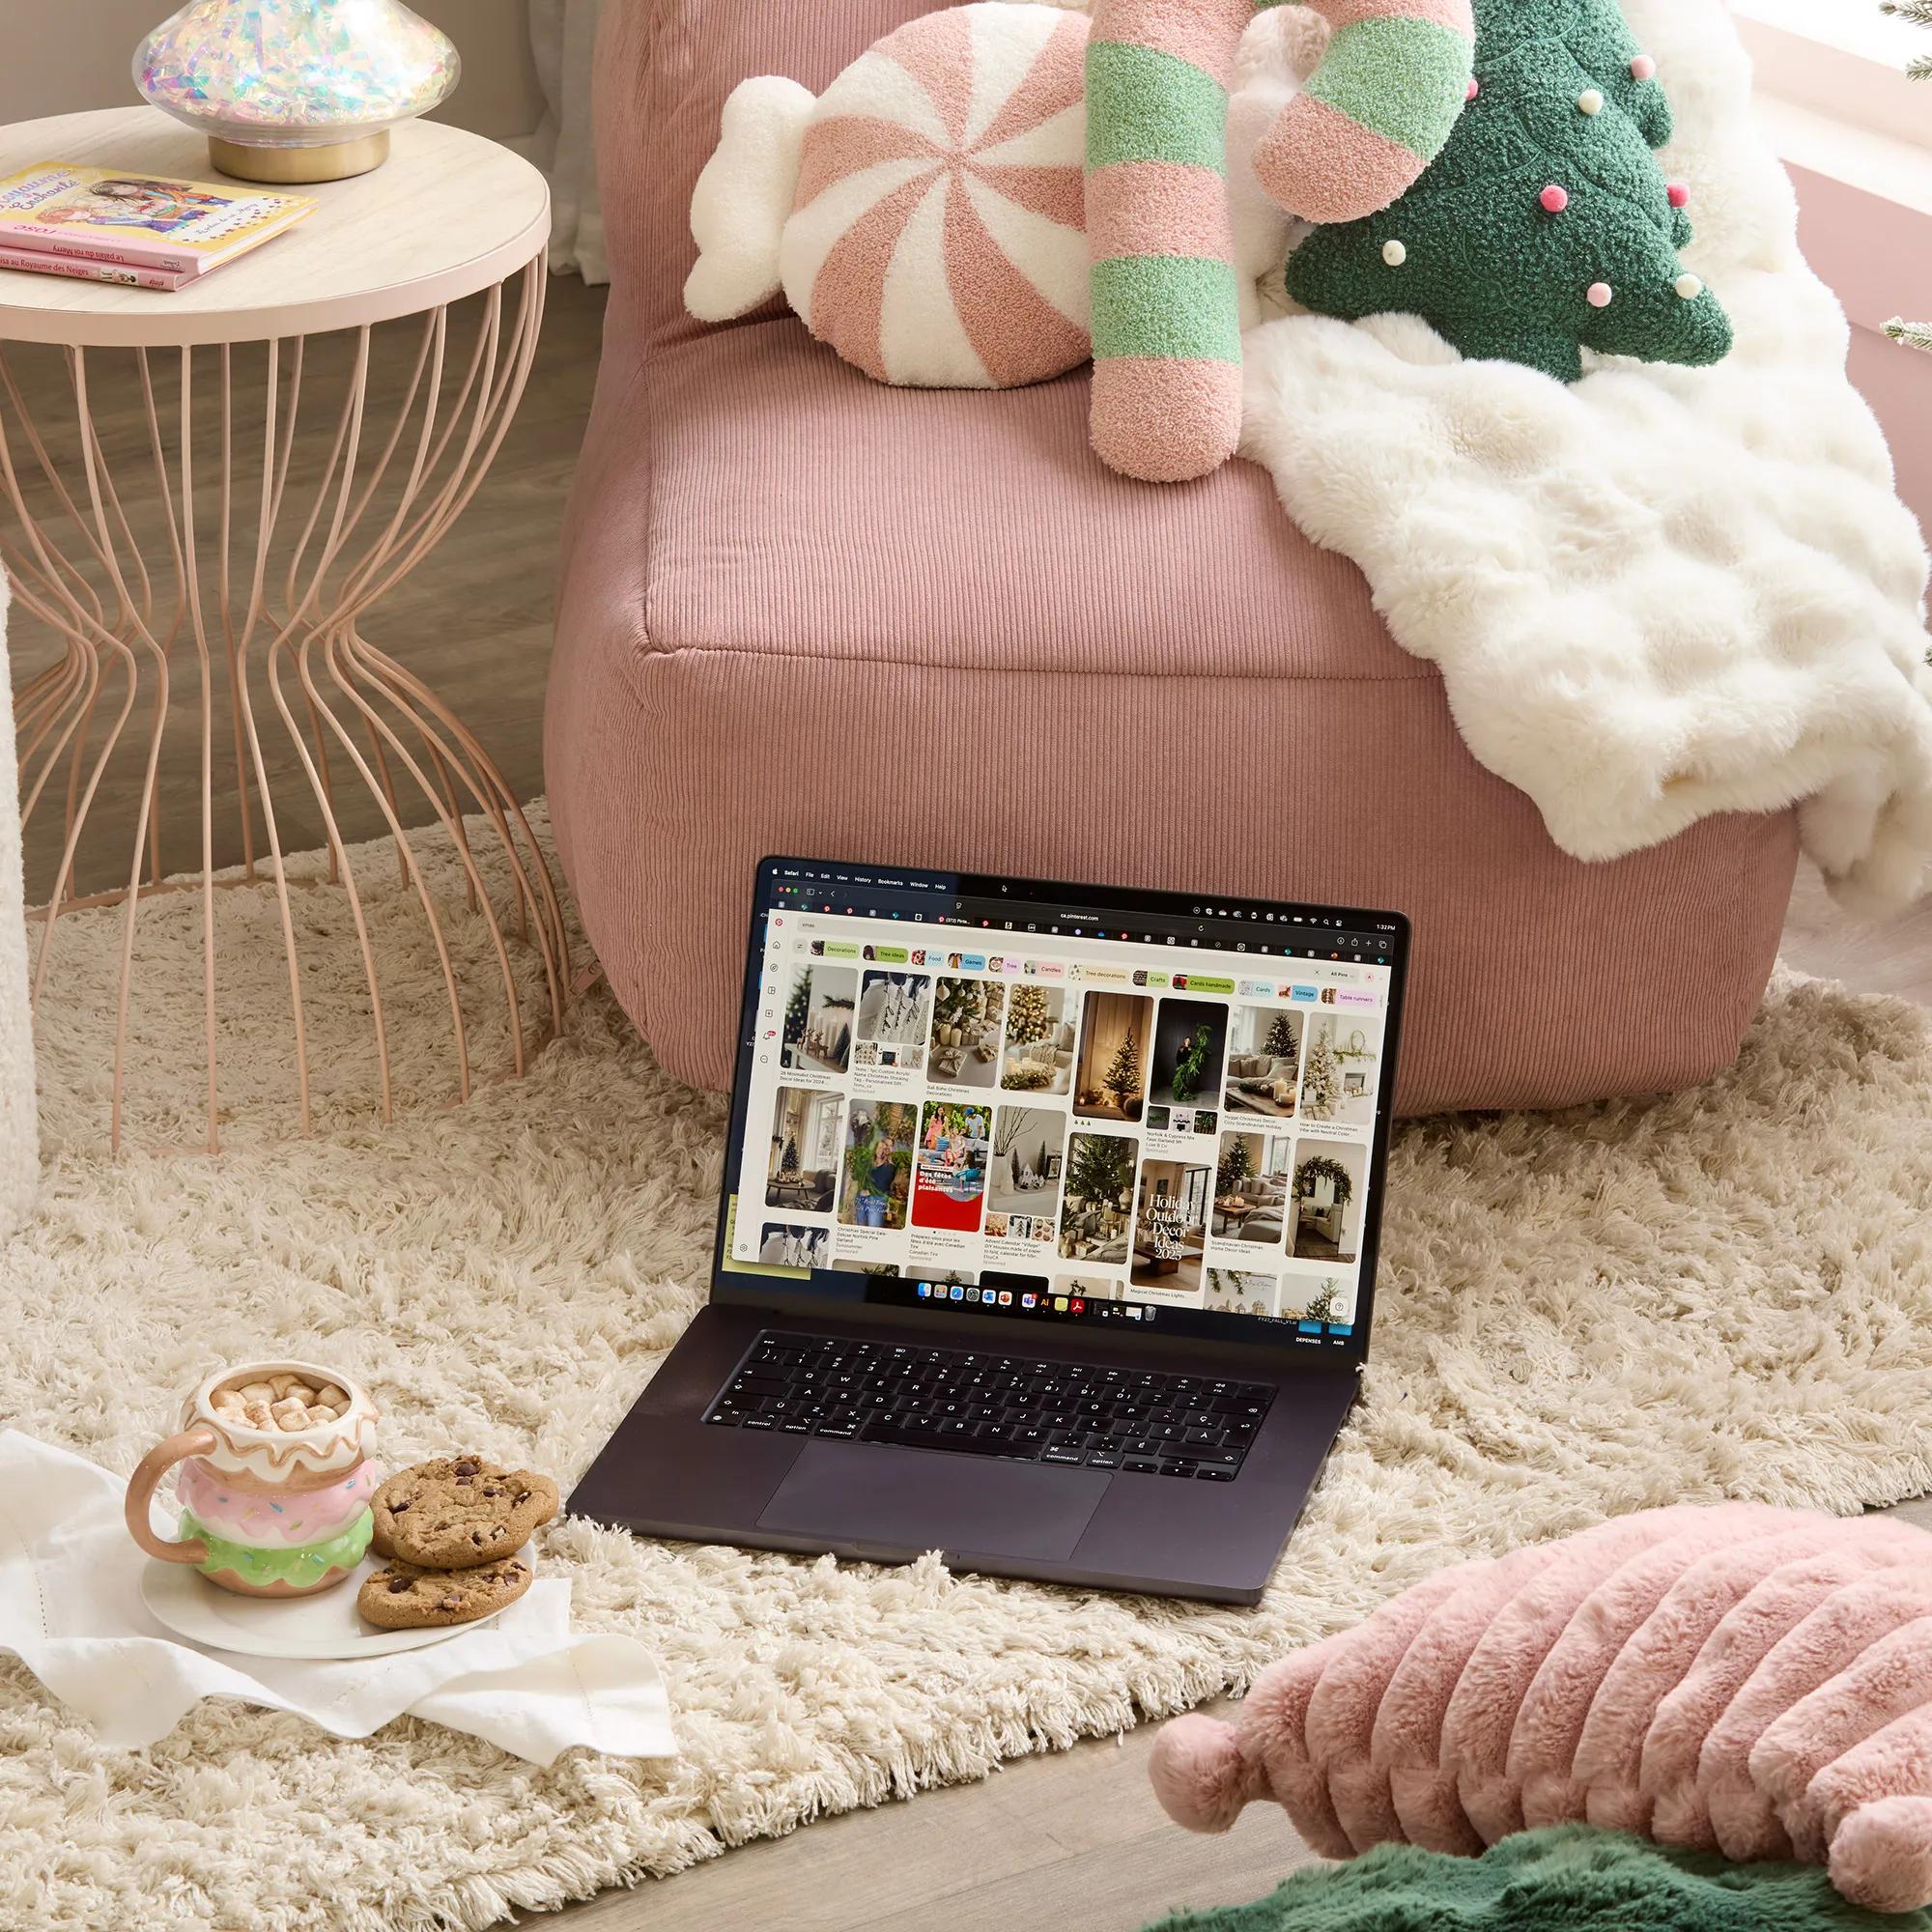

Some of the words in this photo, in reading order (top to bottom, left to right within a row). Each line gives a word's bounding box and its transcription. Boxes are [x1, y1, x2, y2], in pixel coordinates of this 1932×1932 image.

[52, 244, 73, 255] Merry
[85, 249, 95, 259] du
[96, 251, 115, 261] palais
[20, 259, 52, 270] Royaume
[52, 263, 65, 272] des
[66, 266, 89, 276] Neiges
[877, 878, 904, 887] Bookmarks
[1060, 913, 1099, 922] ca.pinterest.com
[827, 946, 857, 954] Decorations
[965, 958, 982, 967] Games
[1097, 972, 1126, 980] decorations
[1190, 980, 1207, 988] Cards
[1207, 980, 1232, 990] handmade
[1294, 989, 1315, 998] Vintage
[1352, 995, 1373, 1004] runners
[1150, 1194, 1196, 1215] Holiday
[1146, 1208, 1198, 1225] Outdoor
[1152, 1221, 1189, 1237] Decor
[1153, 1236, 1184, 1250] Ideas
[1211, 1239, 1240, 1248] Scandinavian
[1155, 1248, 1182, 1261] 2025
[1130, 1288, 1148, 1296] Magical
[1148, 1290, 1170, 1298] Christmas
[1295, 1336, 1321, 1345] DEPENSES
